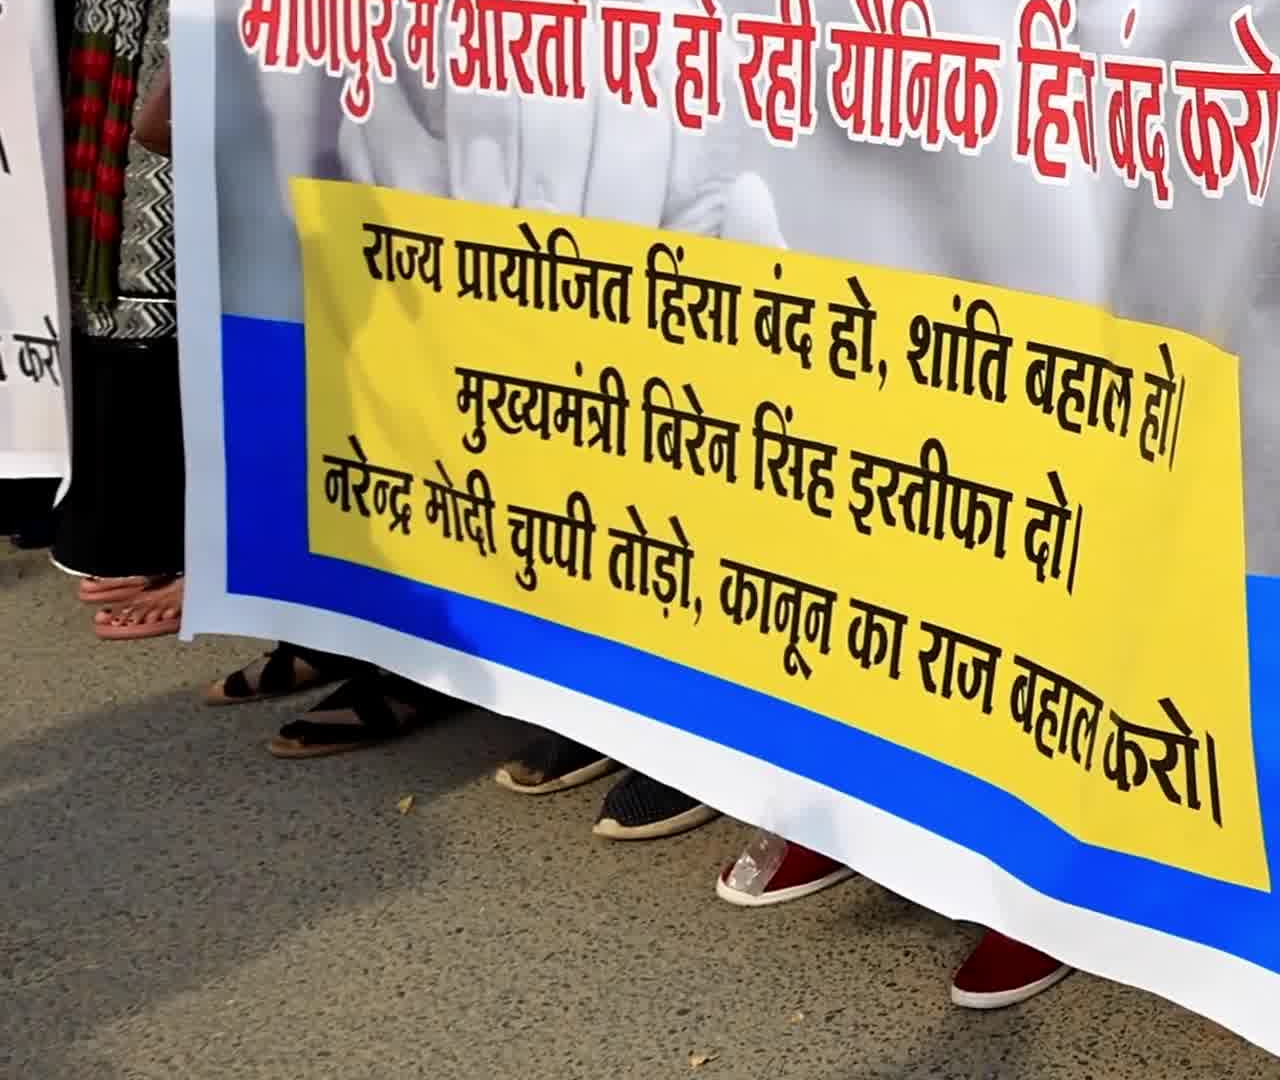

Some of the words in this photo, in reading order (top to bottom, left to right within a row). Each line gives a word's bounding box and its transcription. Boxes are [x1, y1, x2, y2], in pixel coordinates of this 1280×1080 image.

[601, 6, 661, 108] पर
[1104, 8, 1169, 201] बंद
[362, 222, 444, 293] राज्य
[454, 222, 633, 325] प्रायोजित
[644, 241, 742, 345] हिंसा
[753, 262, 815, 370] बंद
[827, 275, 889, 391] हो,
[907, 293, 1013, 404] शांति
[1025, 340, 1134, 438] बहाल
[454, 360, 630, 456] मुख्यमंत्री
[642, 376, 740, 484] बिरेन
[753, 400, 838, 519] सिंह
[848, 437, 1013, 560] इस्तीफा
[322, 434, 414, 536] नरेन्द्र
[424, 458, 497, 558] मोदी
[506, 491, 596, 592] चुप्पी
[719, 557, 838, 681] कानून
[847, 598, 908, 681] का
[918, 620, 1002, 716] राज
[1010, 655, 1104, 772] बहाल
